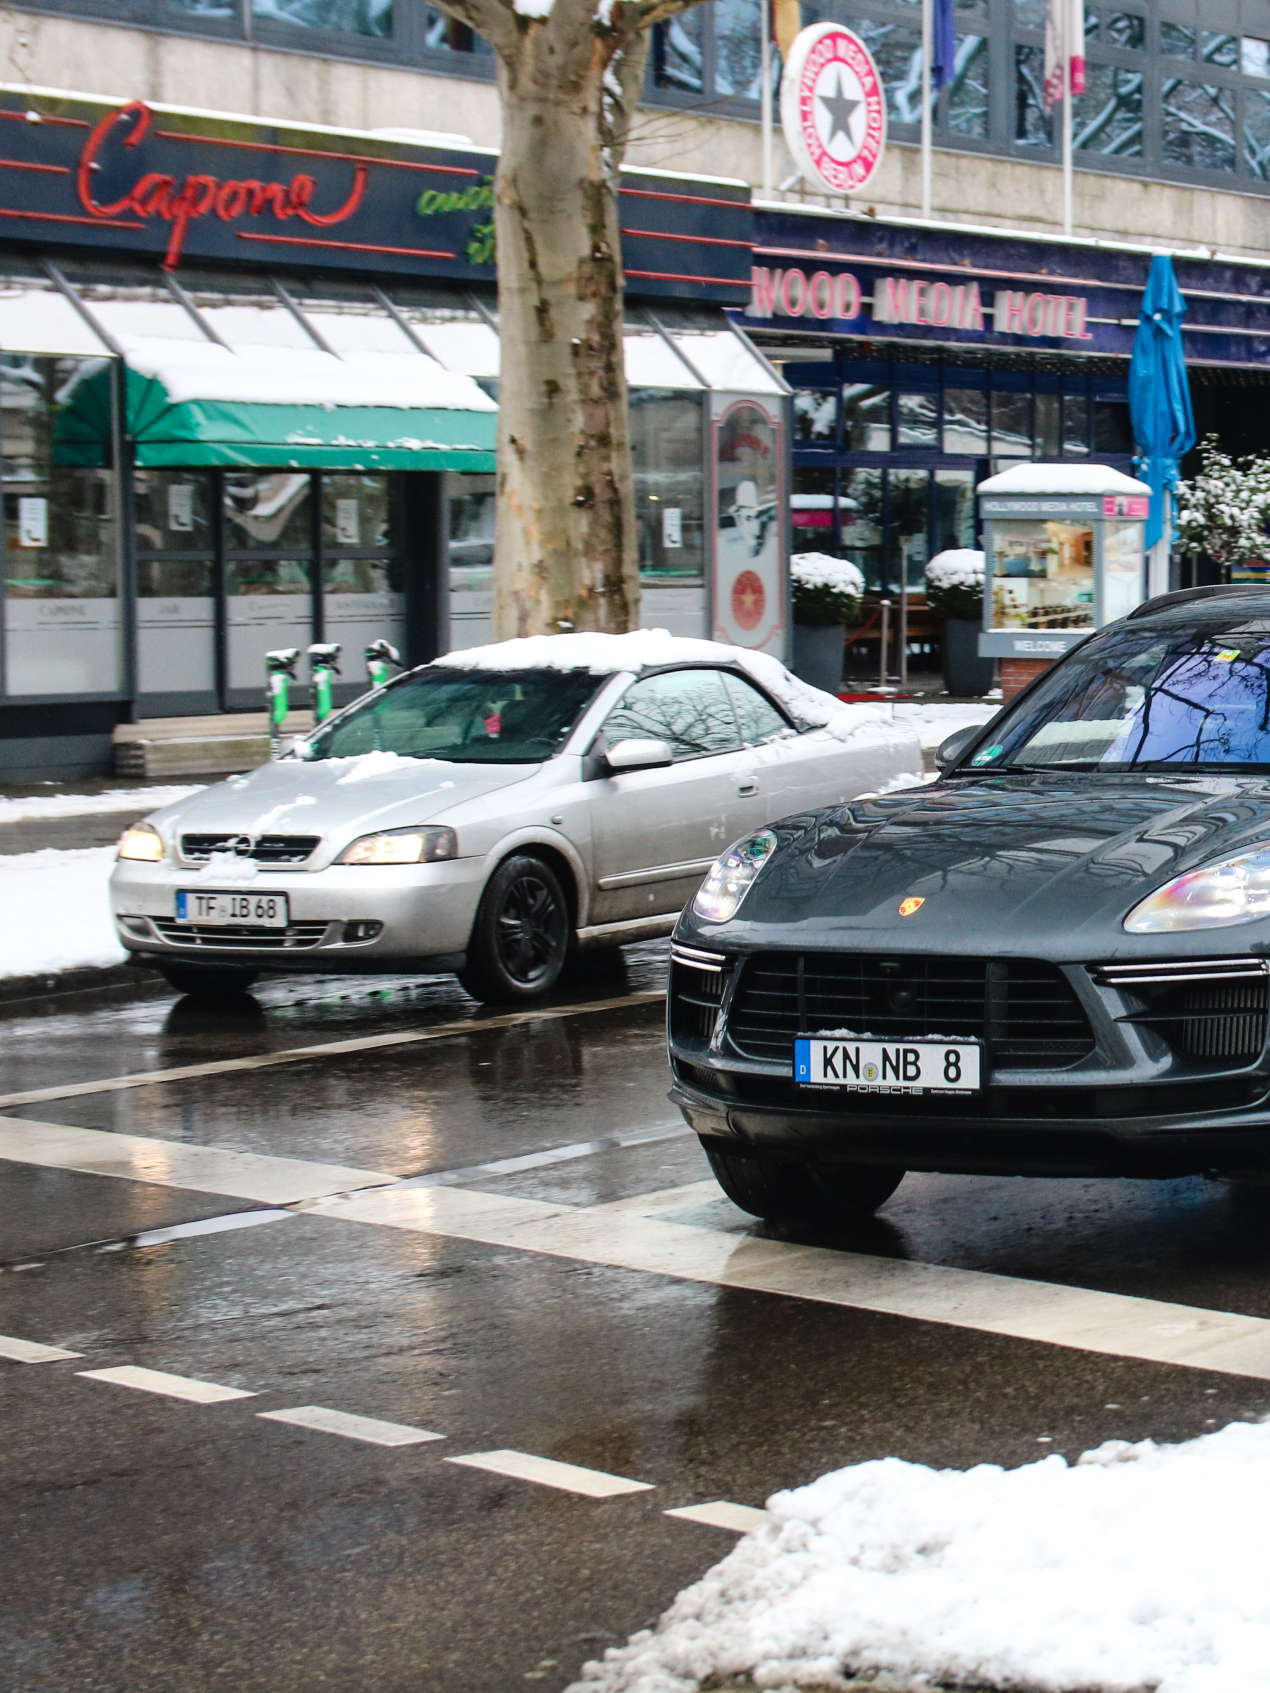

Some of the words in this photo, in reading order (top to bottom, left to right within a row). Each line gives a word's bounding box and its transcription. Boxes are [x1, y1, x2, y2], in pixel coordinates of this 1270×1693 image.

[857, 96, 882, 162] HOTEL
[78, 100, 369, 271] Capone
[878, 276, 985, 331] MEDIA
[996, 290, 1093, 340] HOTEL
[984, 501, 1039, 511] HOLLYWOOD
[1040, 502, 1068, 512] MEDIA
[1069, 502, 1099, 512] HOTEL
[1013, 640, 1067, 652] WELCOME
[195, 895, 217, 917] TF
[229, 897, 250, 919] IB
[254, 898, 277, 919] 68
[799, 1065, 807, 1075] D
[823, 1045, 861, 1080] KN
[881, 1047, 921, 1081] NB
[943, 1049, 962, 1083] 8
[847, 1084, 923, 1095] PORSCHE
